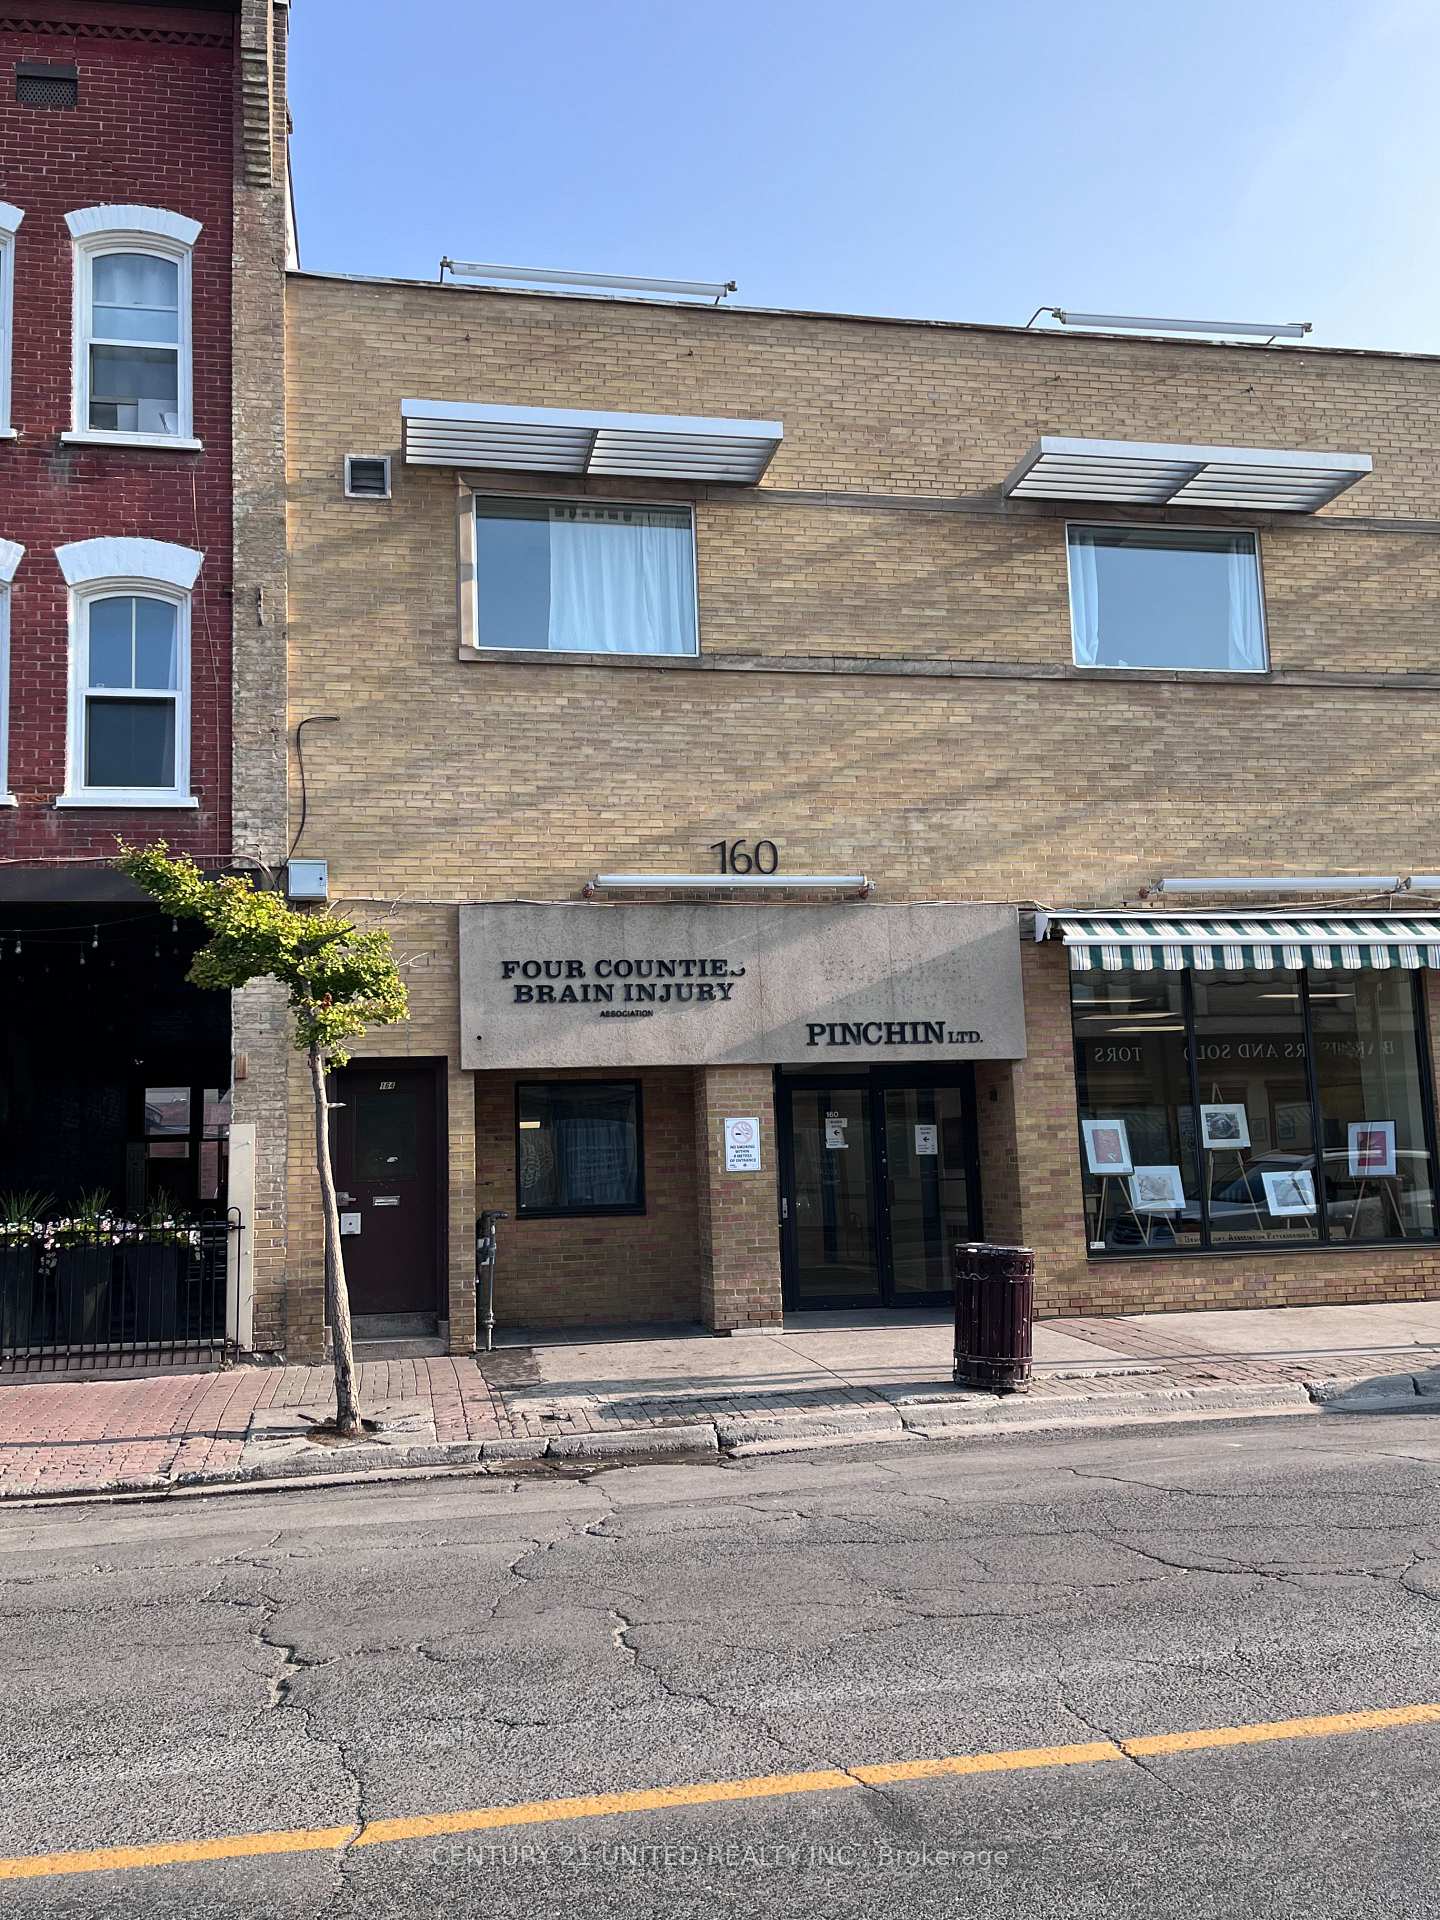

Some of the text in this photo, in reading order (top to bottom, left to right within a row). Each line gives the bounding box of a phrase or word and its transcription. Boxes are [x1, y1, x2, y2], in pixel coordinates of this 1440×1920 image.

[710, 839, 778, 875] 160
[501, 960, 586, 980] FOUR
[513, 982, 734, 1004] BRAIN INJURY
[600, 1009, 654, 1018] ASSOCIATION
[806, 1021, 983, 1046] PINCHIN LTD.
[379, 1081, 396, 1090] 164
